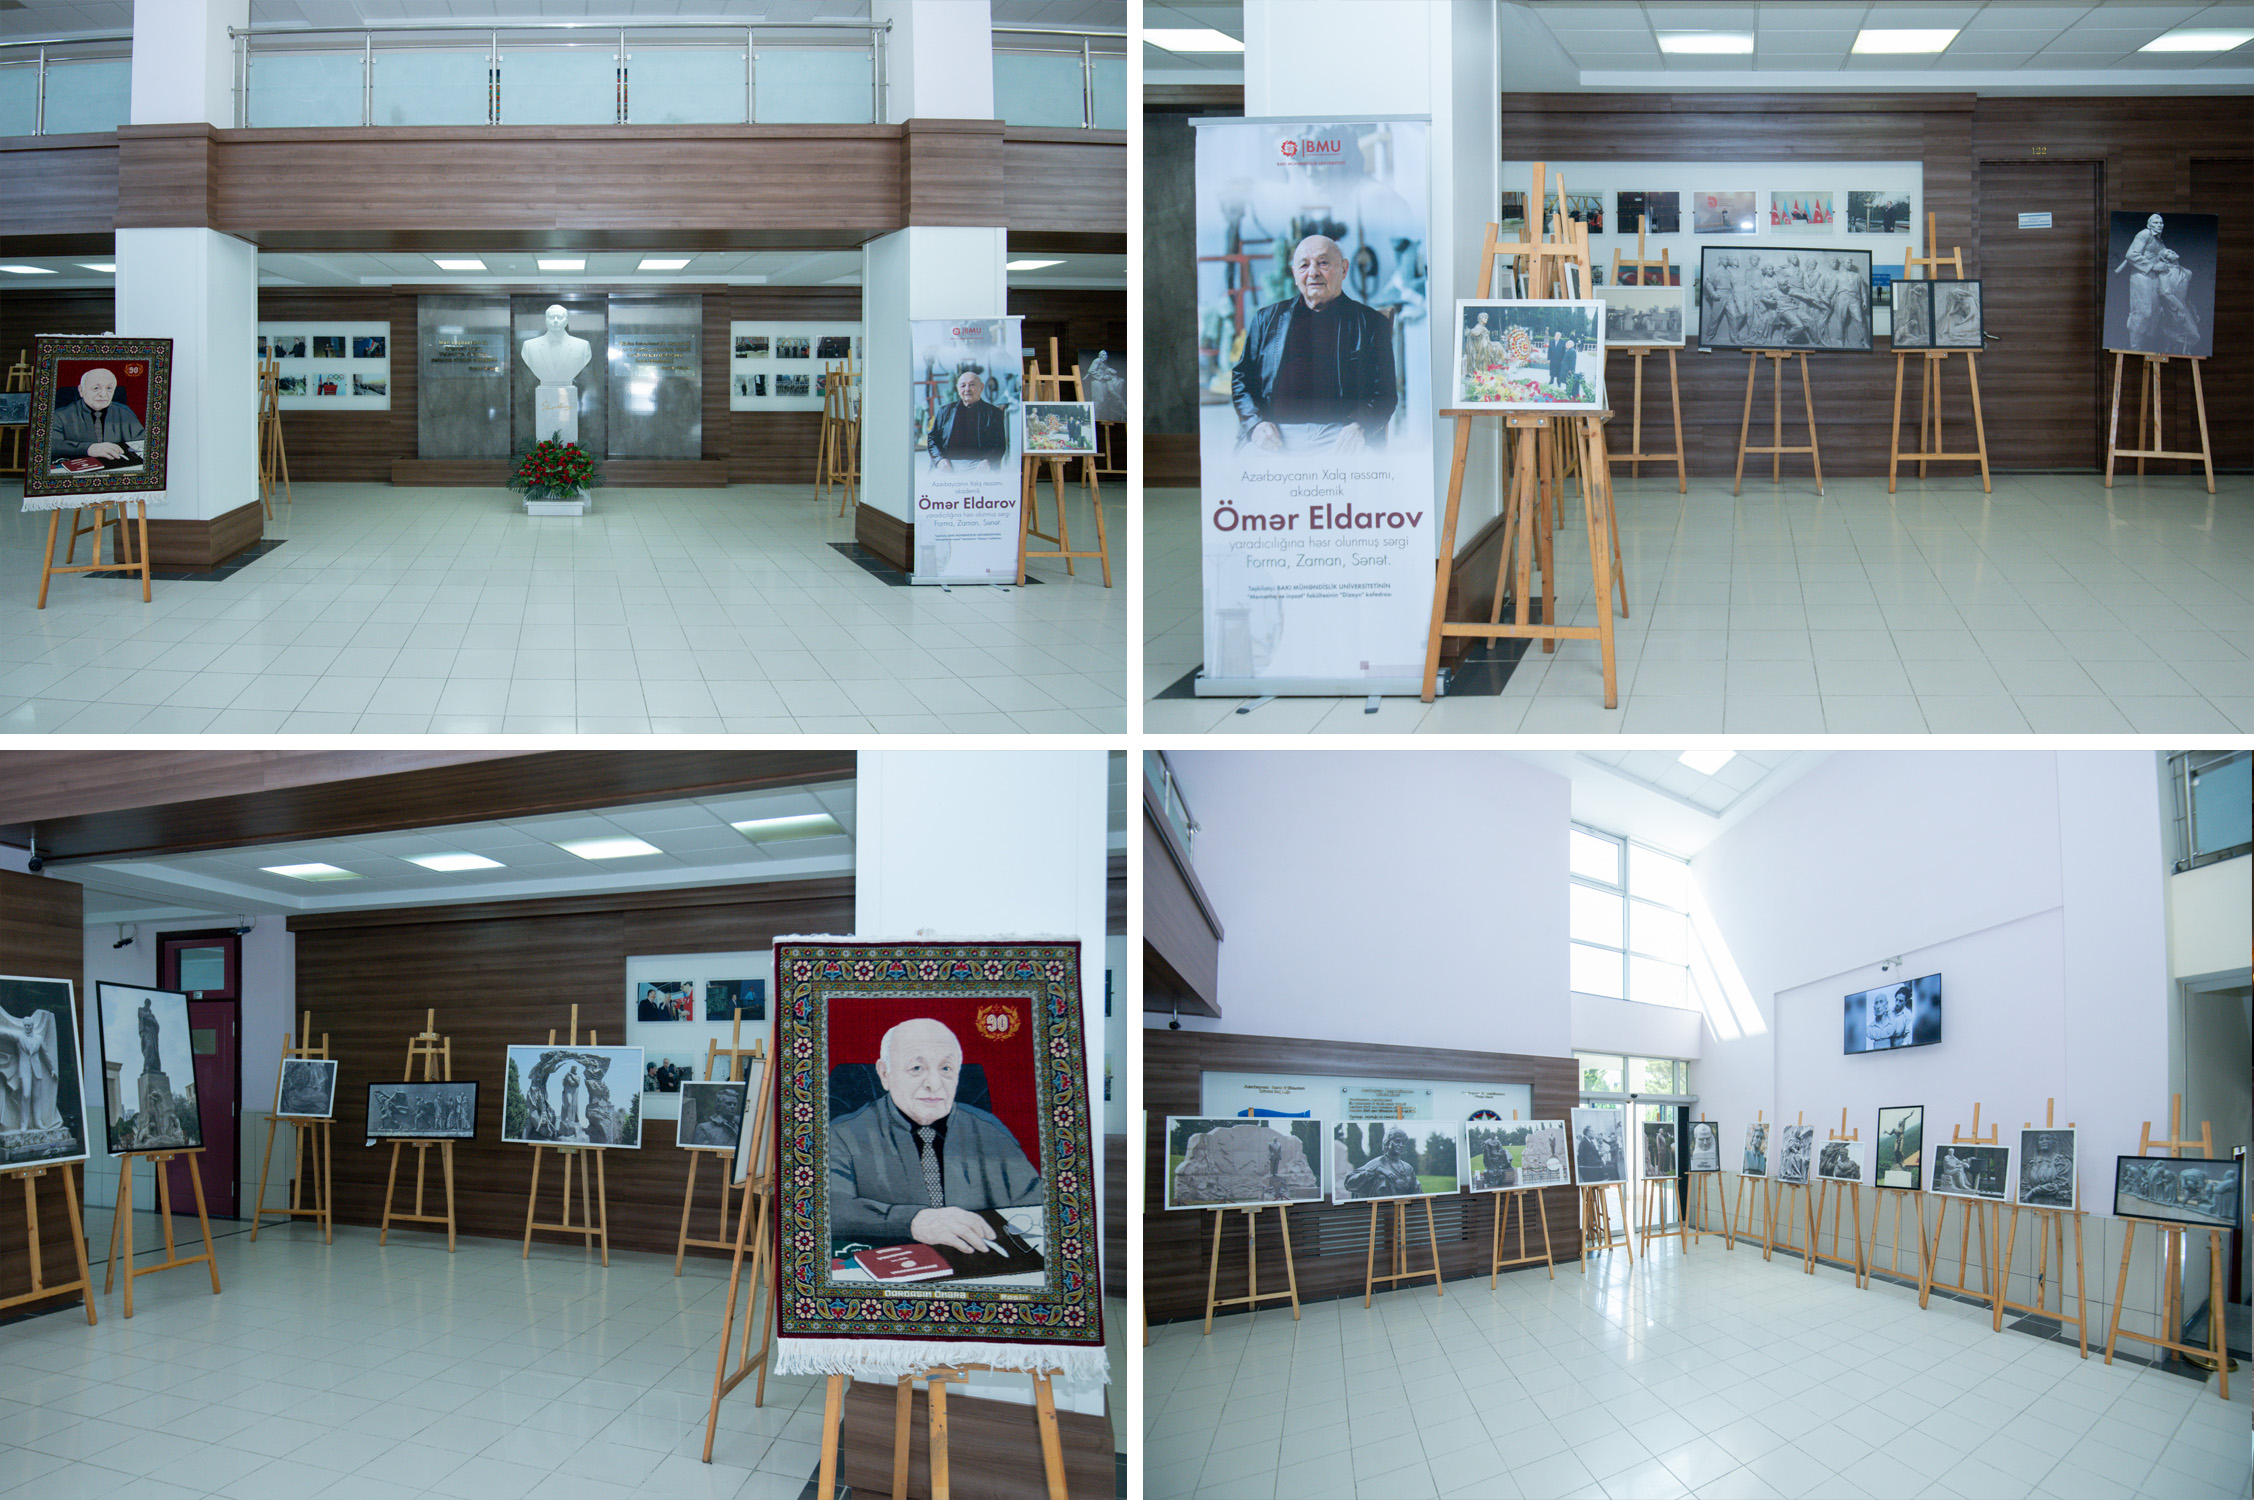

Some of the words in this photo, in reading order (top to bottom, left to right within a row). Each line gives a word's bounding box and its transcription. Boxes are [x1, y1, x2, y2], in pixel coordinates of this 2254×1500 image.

[1306, 140, 1341, 153] BMU
[2031, 147, 2047, 155] 122
[1241, 469, 1318, 484] Azərbaycanın
[1322, 468, 1347, 483] Xalq
[1350, 471, 1395, 481] rəssamı,
[1290, 485, 1344, 497] akademik
[919, 495, 960, 510] Ömər
[963, 496, 1016, 509] Eldarov
[1213, 499, 1299, 532] Ömər
[1309, 502, 1424, 530] Eldarov
[1229, 536, 1305, 552] yaradıcılığına
[1309, 536, 1331, 548] həsr
[1335, 535, 1380, 548] olunmuş
[1383, 536, 1409, 550] sərgi
[1246, 554, 1291, 569] Forma,
[1296, 553, 1346, 568] Zaman,
[1351, 552, 1392, 567] Sənət.
[987, 1014, 1008, 1032] 90
